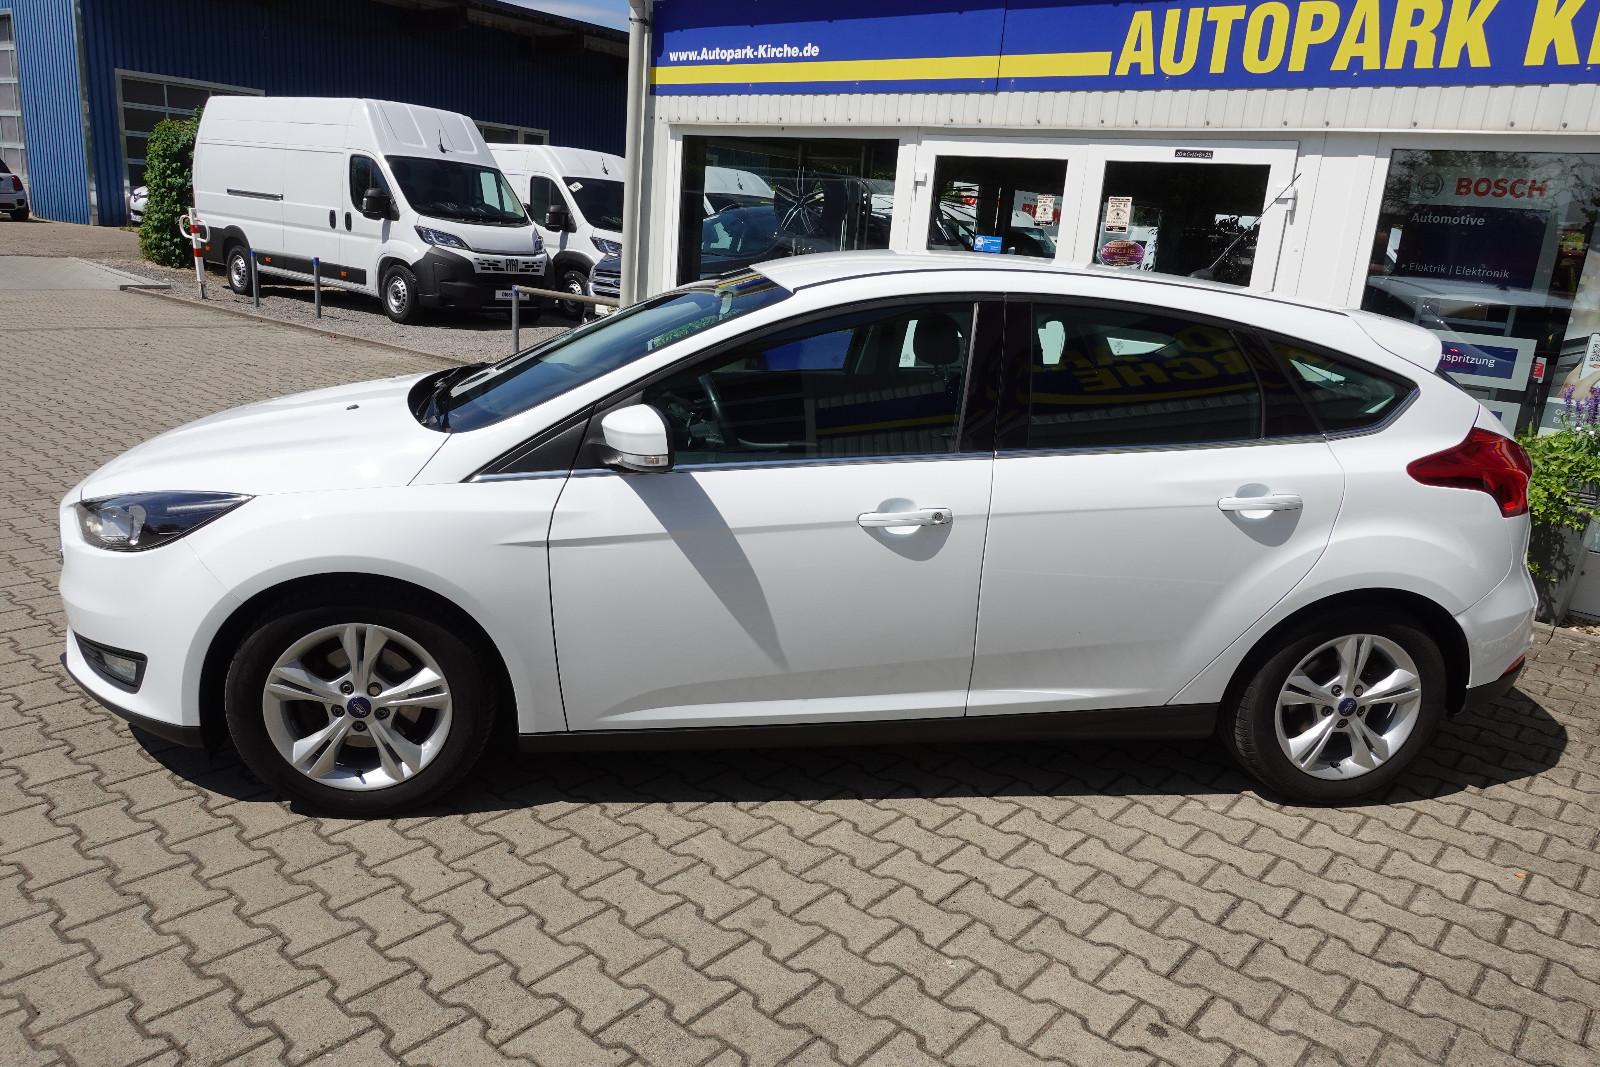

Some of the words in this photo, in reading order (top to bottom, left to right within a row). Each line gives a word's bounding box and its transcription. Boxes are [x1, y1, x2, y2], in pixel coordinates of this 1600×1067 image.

[1115, 0, 1498, 75] AUTOPARK
[669, 43, 820, 62] www.Autopark-Kirche.de
[1455, 176, 1548, 199] BOSCH
[1411, 212, 1486, 226] Automotive
[1409, 263, 1446, 273] Elektrik
[1455, 266, 1510, 278] Elektronik
[1440, 353, 1496, 367] nspritzung
